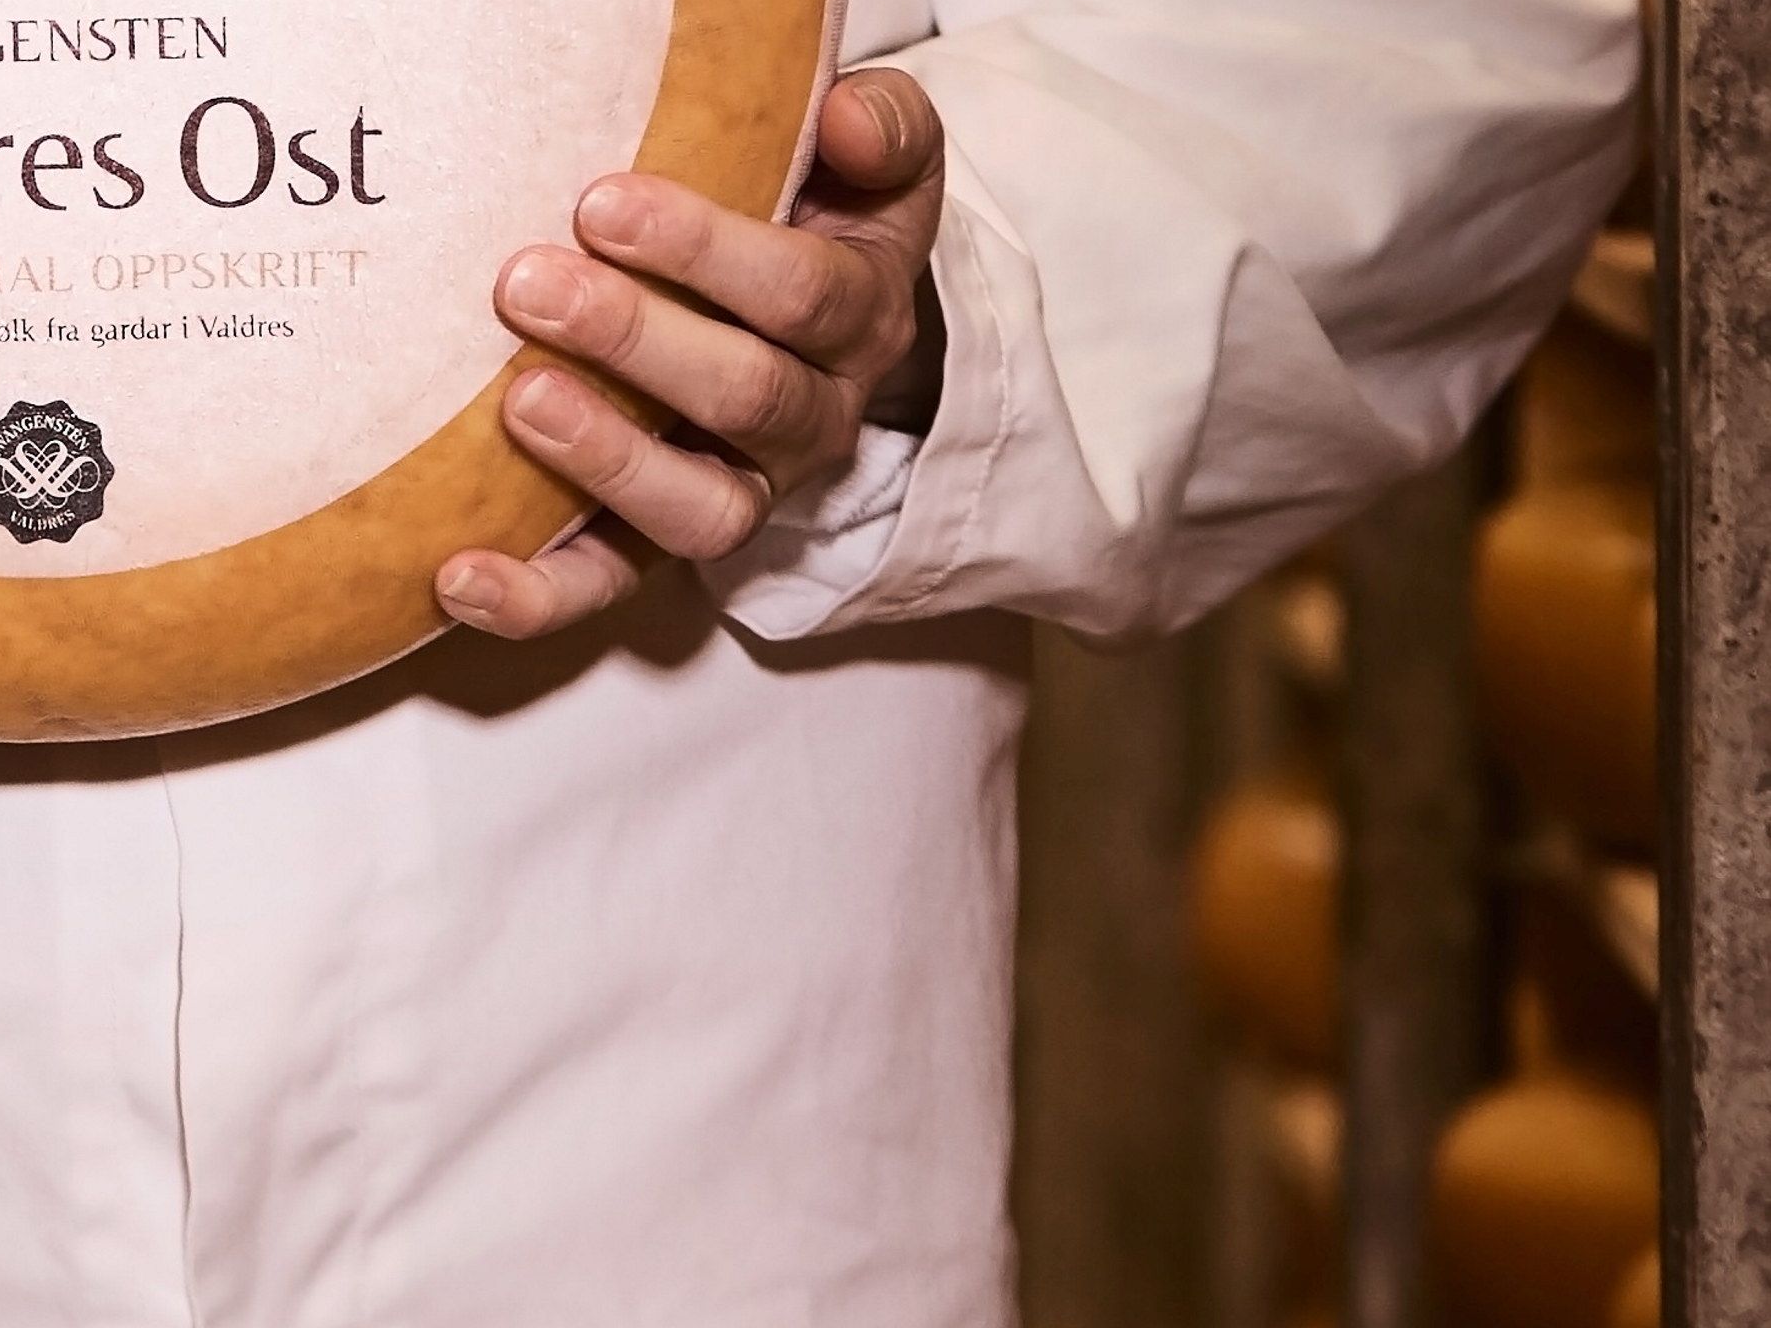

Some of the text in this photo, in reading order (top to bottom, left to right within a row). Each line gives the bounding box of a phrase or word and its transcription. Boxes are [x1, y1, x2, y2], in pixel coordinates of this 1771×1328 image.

[179, 96, 387, 208] Ost
[92, 251, 367, 291] OPPSKRIFT
[47, 317, 79, 341] fra
[91, 316, 171, 348] gardar
[182, 316, 189, 339] i
[198, 315, 294, 338] Valdres
[11, 509, 75, 531] VALDRES
